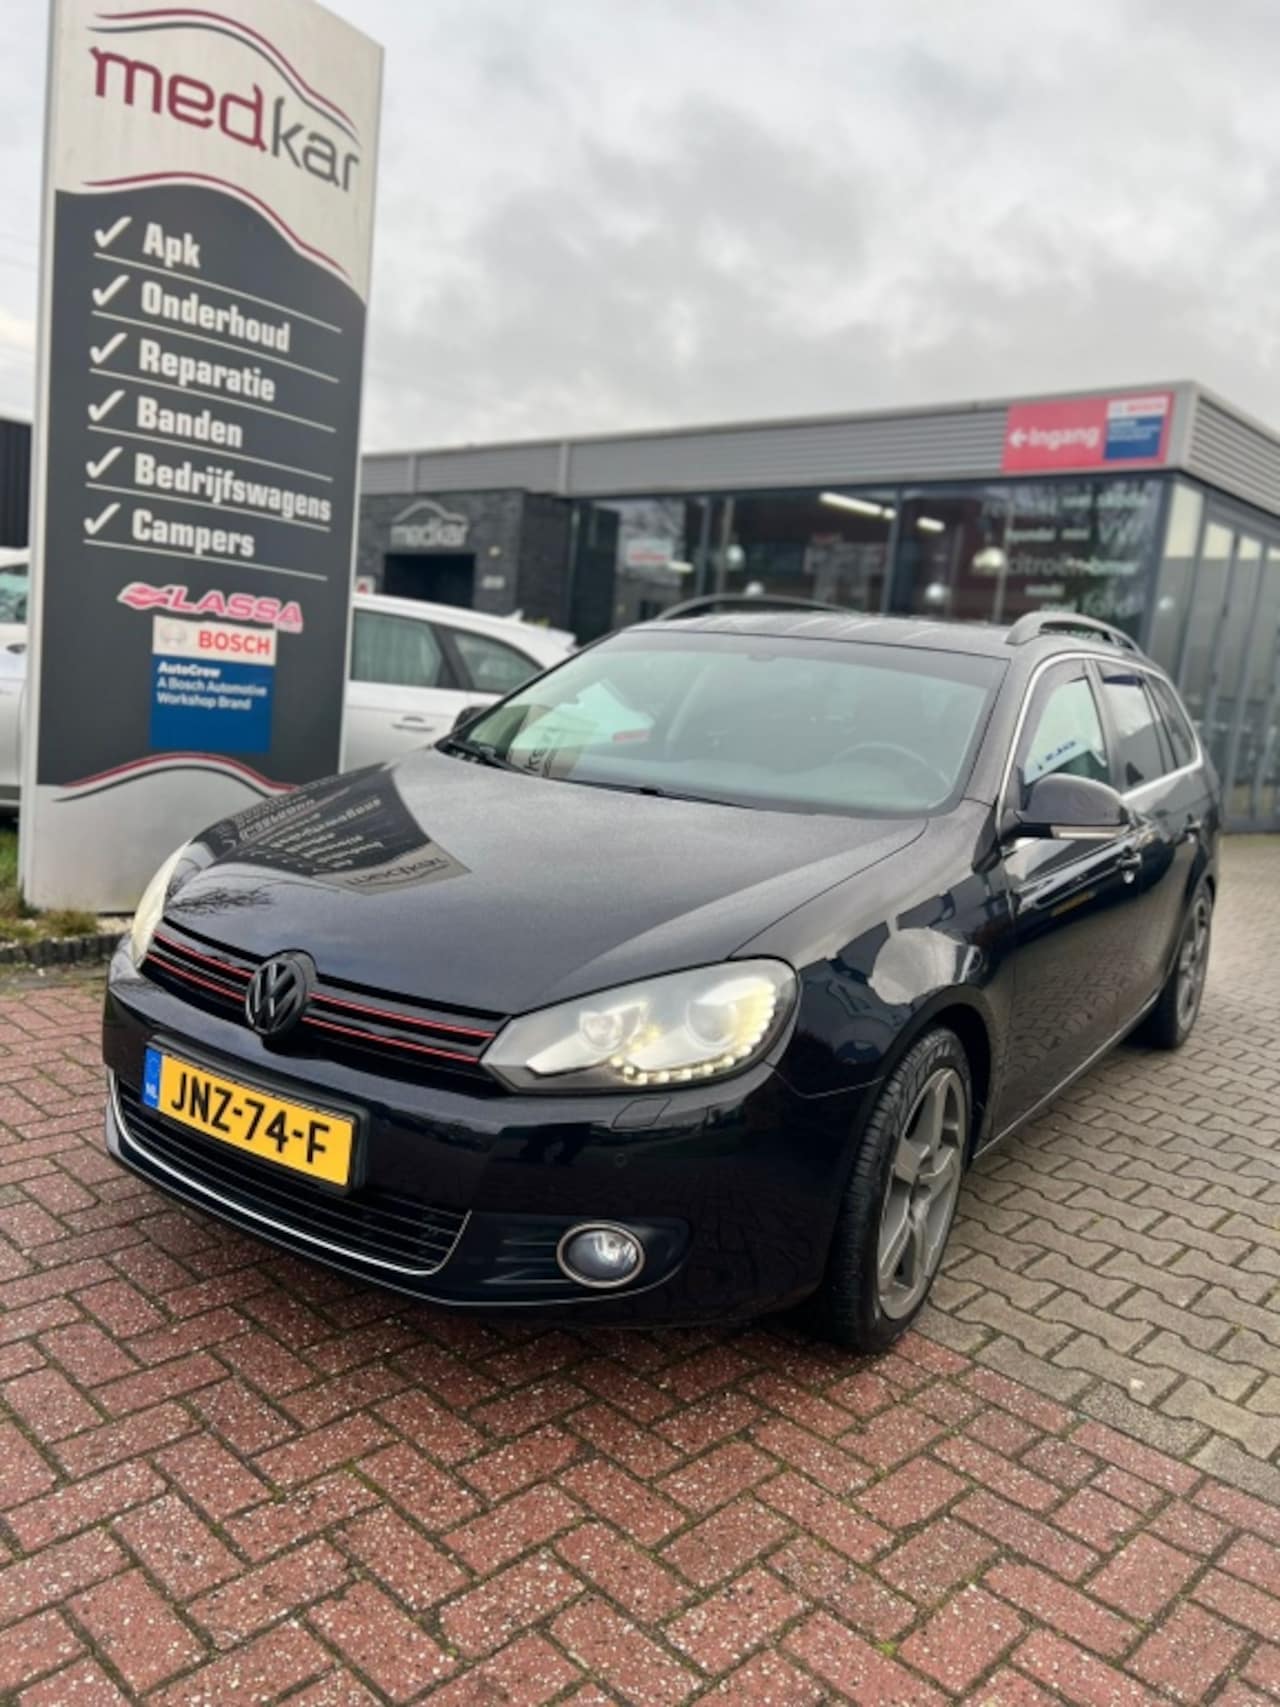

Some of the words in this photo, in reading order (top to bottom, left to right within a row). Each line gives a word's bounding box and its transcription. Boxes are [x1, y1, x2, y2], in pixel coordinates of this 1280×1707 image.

[89, 46, 360, 193] medkar
[142, 222, 201, 269] Apk
[141, 280, 291, 354] Onderhoud
[138, 339, 276, 402] Reparatie
[137, 395, 243, 449] Banden
[135, 453, 332, 523] Bedrijfswagens
[132, 509, 255, 558] Campers
[171, 588, 302, 628] LASSA
[199, 629, 271, 657] BOSCH
[157, 661, 221, 679] AutoCrew
[168, 677, 205, 691] Bosch
[206, 681, 267, 697] Automotive
[157, 691, 216, 709] Workshop
[217, 695, 252, 710] Brand
[170, 1071, 331, 1165] JNZ-74-F
